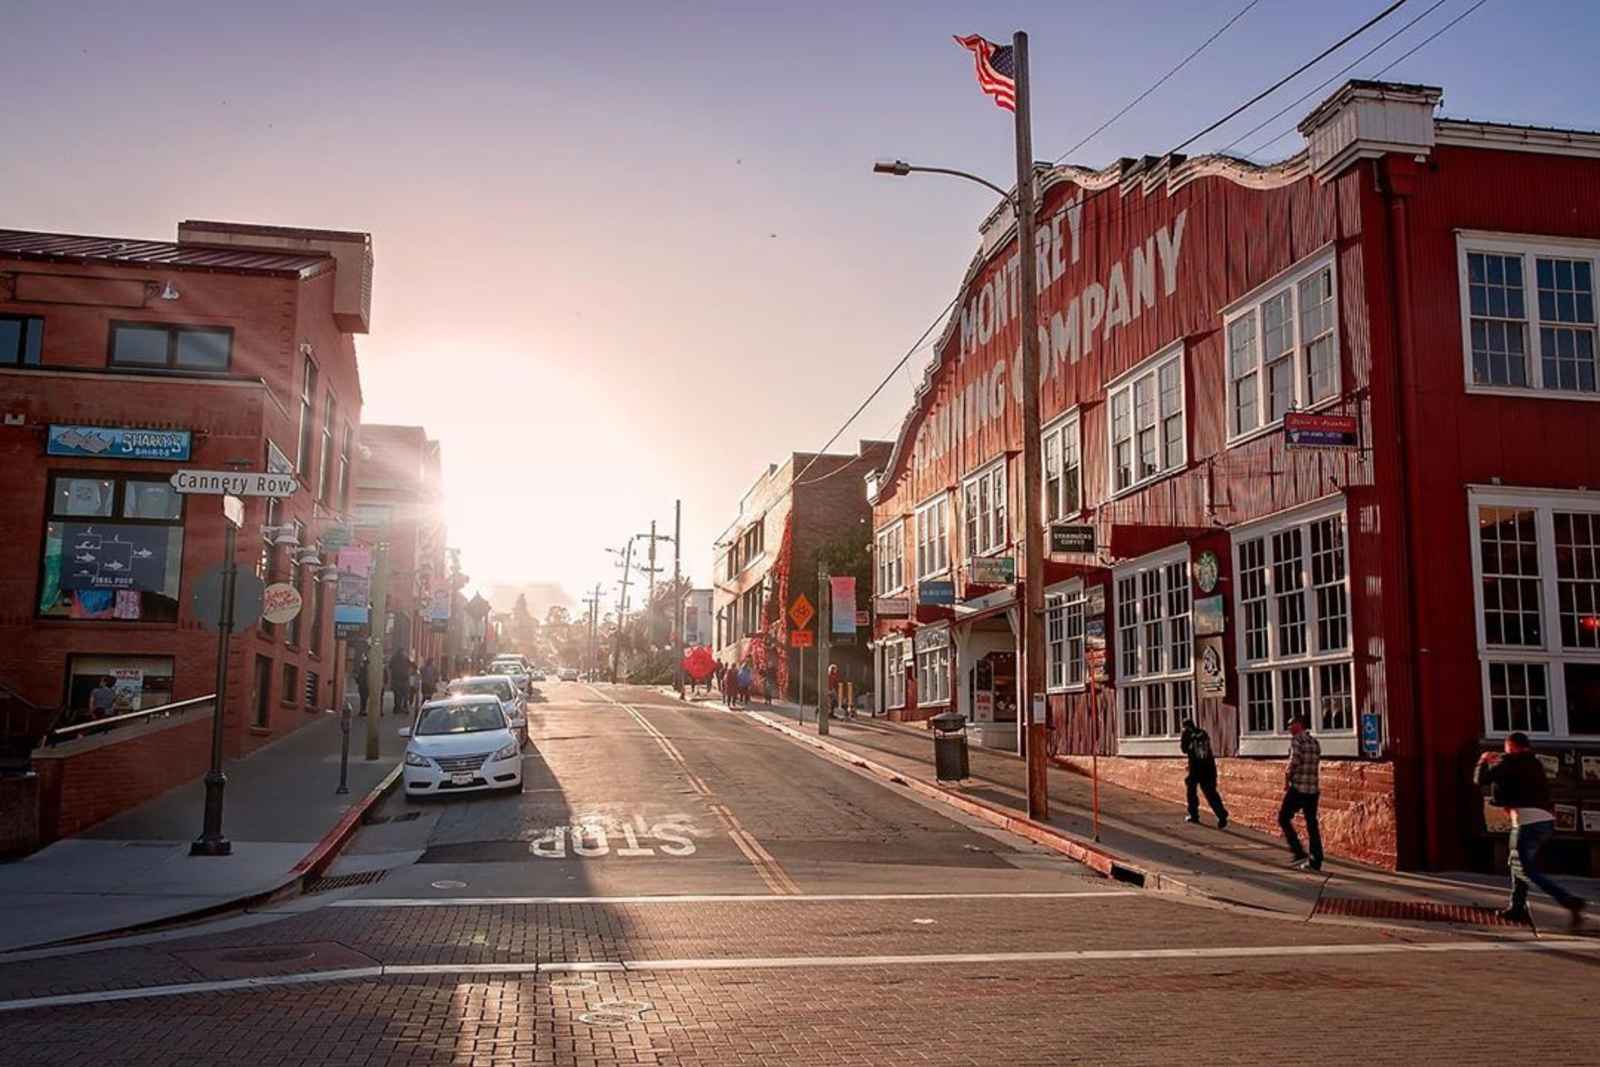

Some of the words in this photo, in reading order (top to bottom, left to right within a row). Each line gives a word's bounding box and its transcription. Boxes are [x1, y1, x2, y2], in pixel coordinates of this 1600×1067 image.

[960, 188, 1083, 361] MONTREY
[178, 473, 248, 495] Cannery
[257, 476, 291, 493] Row
[530, 823, 697, 858] STOP
